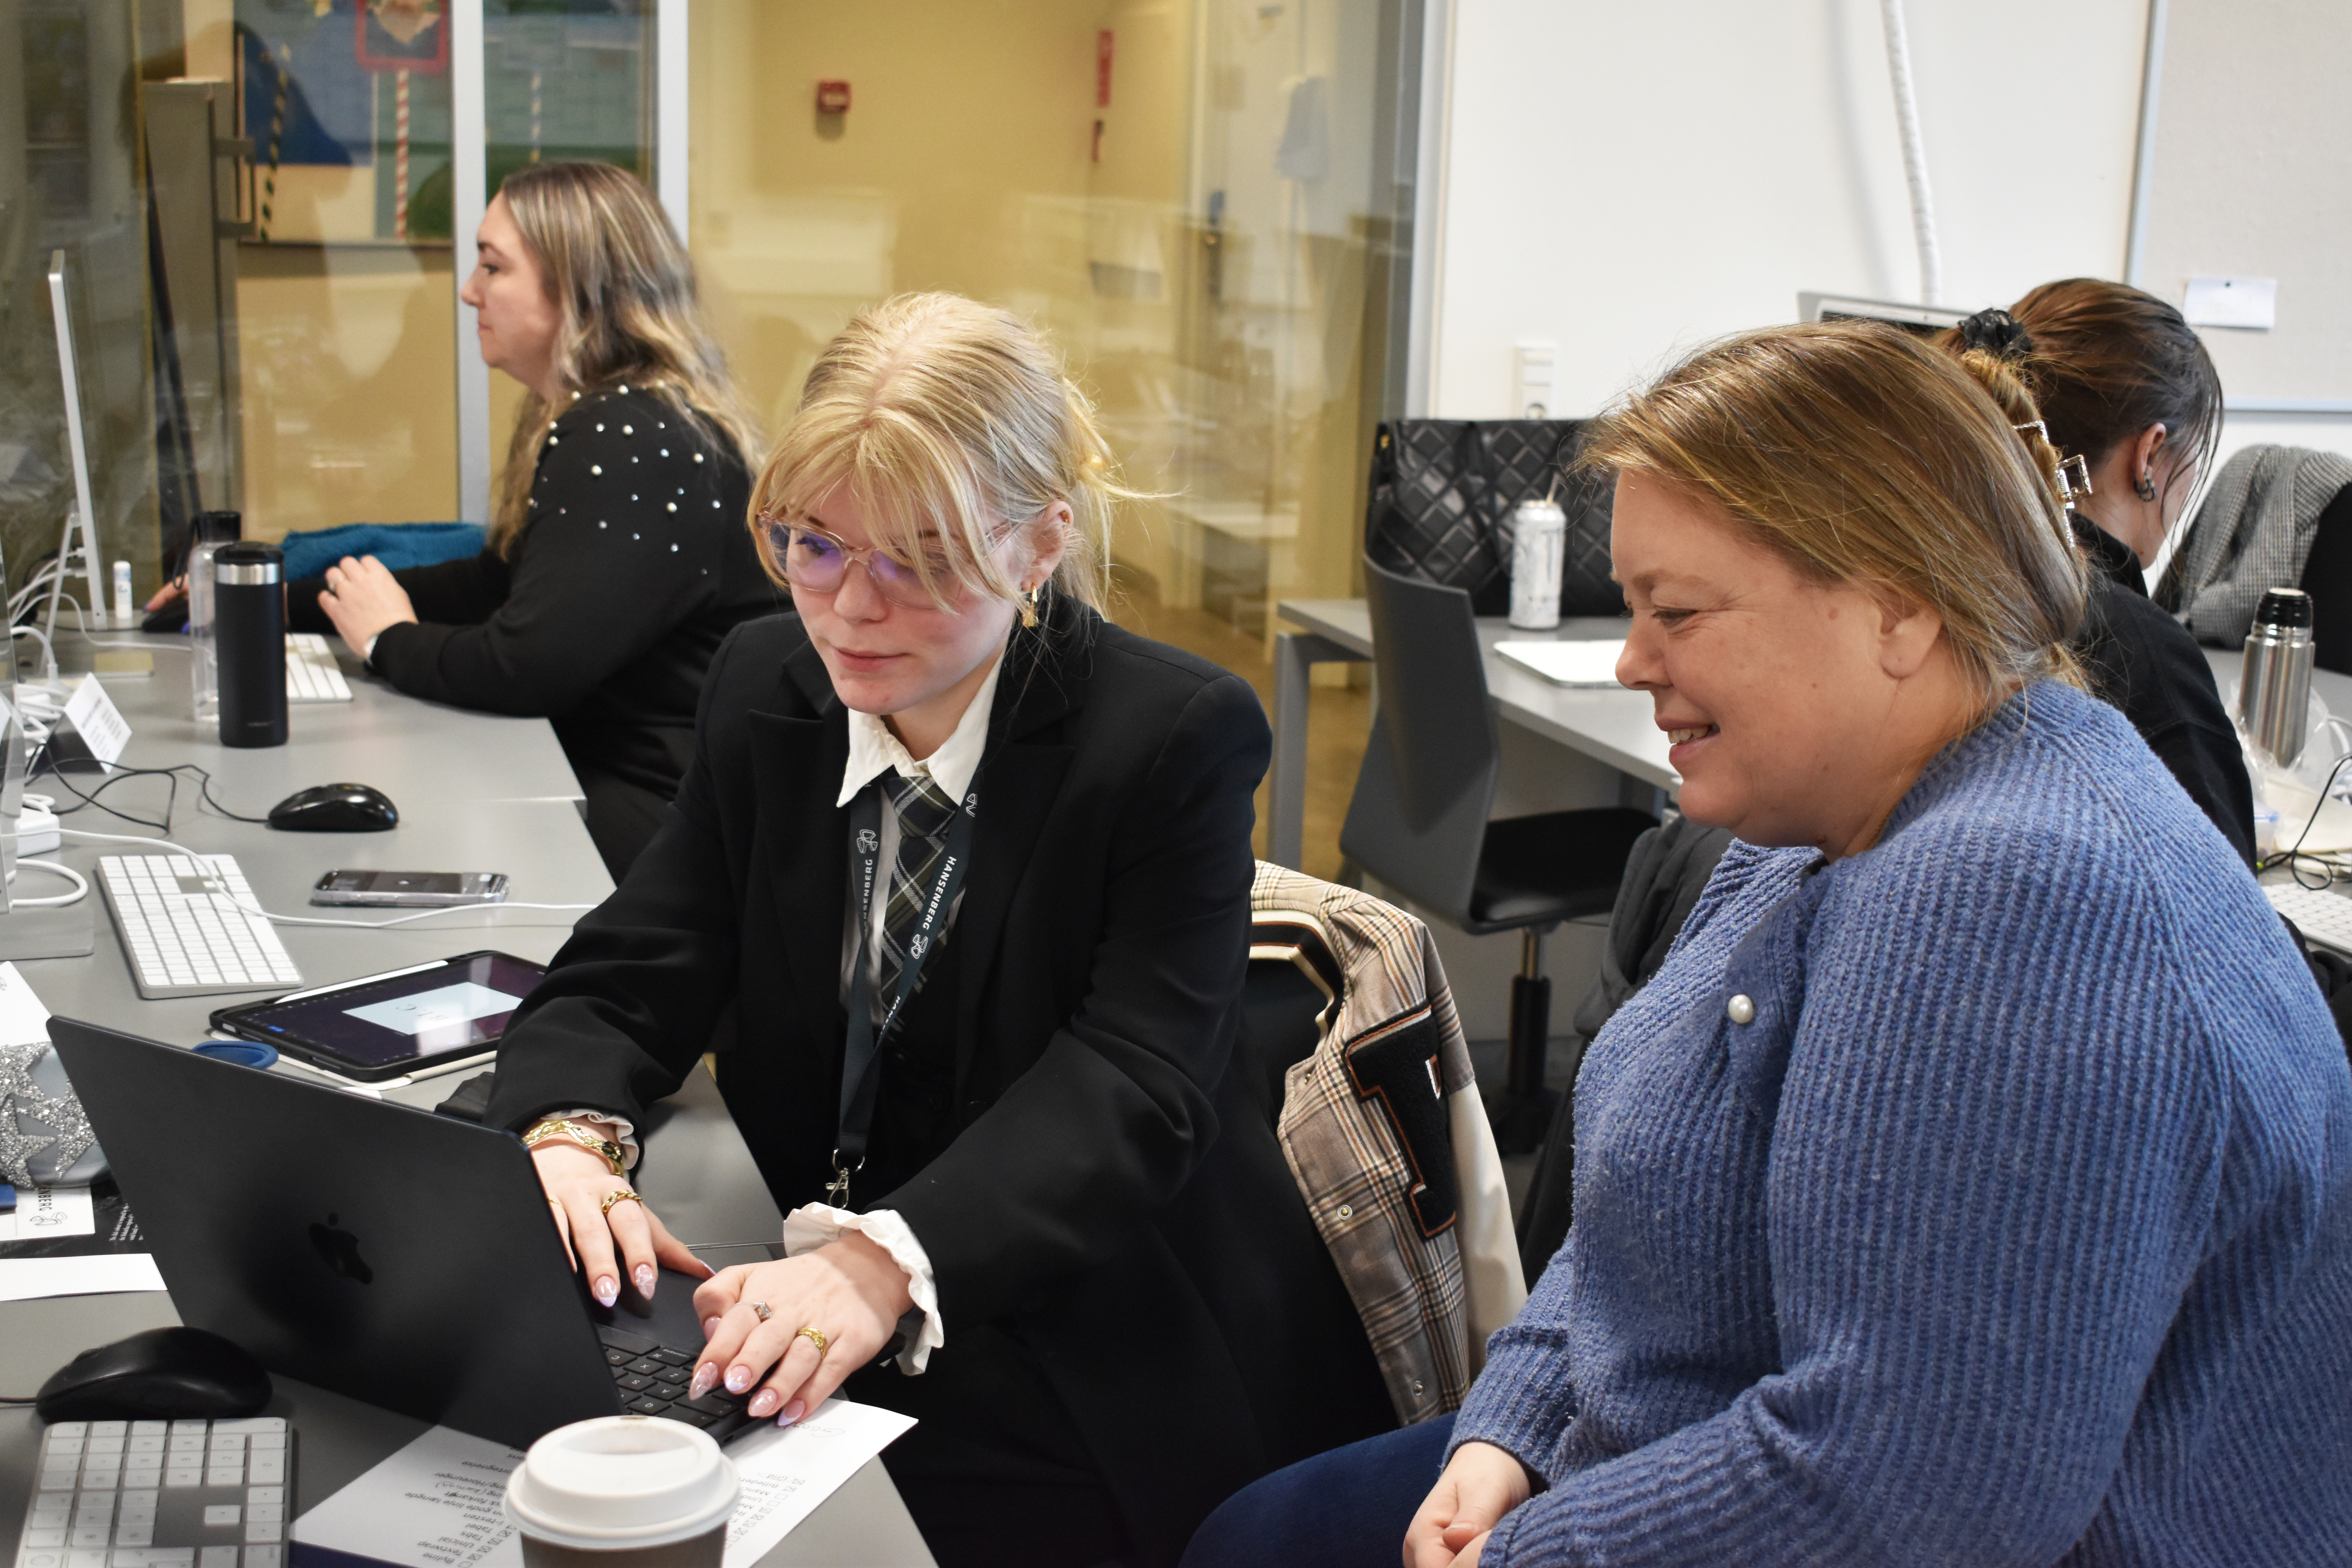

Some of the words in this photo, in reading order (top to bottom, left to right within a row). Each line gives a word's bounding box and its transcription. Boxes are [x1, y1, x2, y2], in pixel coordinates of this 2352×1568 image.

[863, 859, 873, 926] NSENBERG
[923, 856, 957, 930] HANSENBERG
[461, 1461, 513, 1475] ortegnelse
[740, 1477, 779, 1488] Billedet
[742, 1486, 771, 1496] Manc
[741, 1494, 762, 1503] Und
[465, 1523, 493, 1533] Tabel
[460, 1531, 483, 1541] Tabs
[417, 1541, 464, 1557] Textwrap
[423, 1552, 455, 1564] Byline
